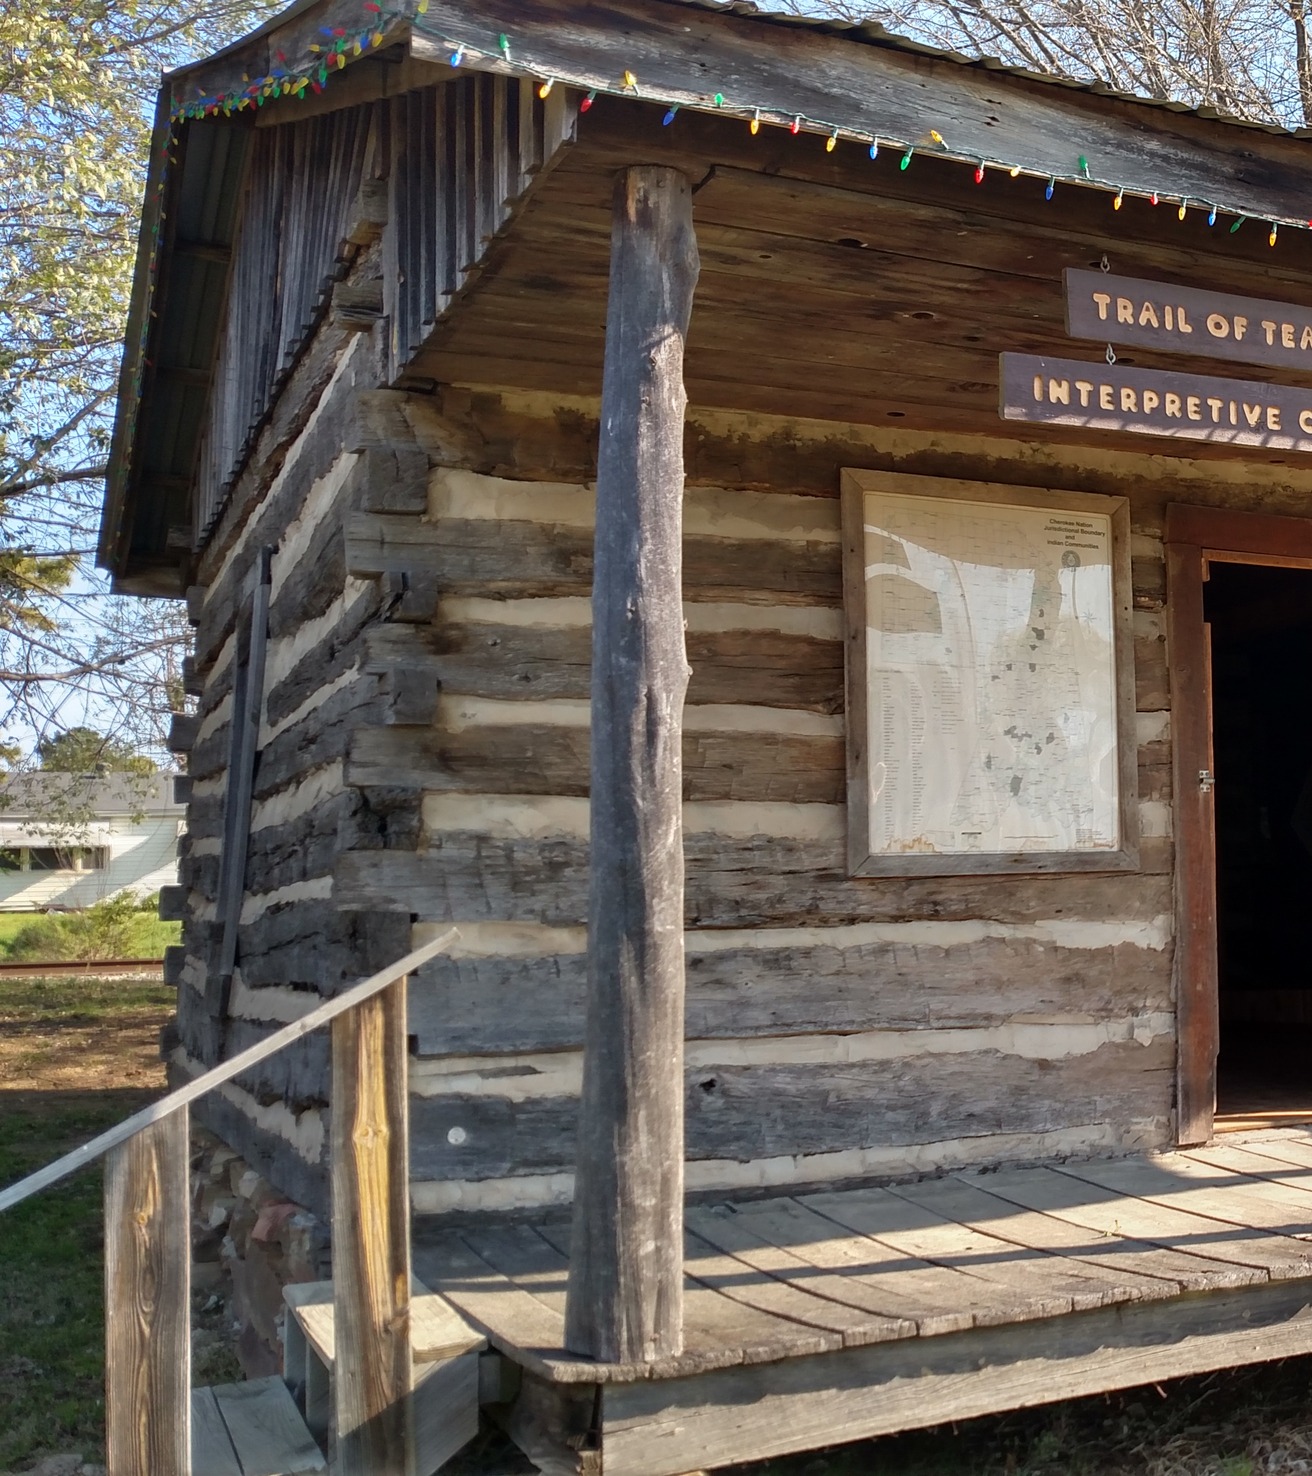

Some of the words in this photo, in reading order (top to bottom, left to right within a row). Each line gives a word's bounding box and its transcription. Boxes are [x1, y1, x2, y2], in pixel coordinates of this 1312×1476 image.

[1093, 292, 1192, 334] TRAIL
[1206, 312, 1247, 341] OF
[1033, 374, 1282, 431] INTERPRETIVE
[1044, 525, 1080, 534] Jurisdictional
[1080, 528, 1106, 537] Boundary
[1064, 541, 1099, 550] Communities
